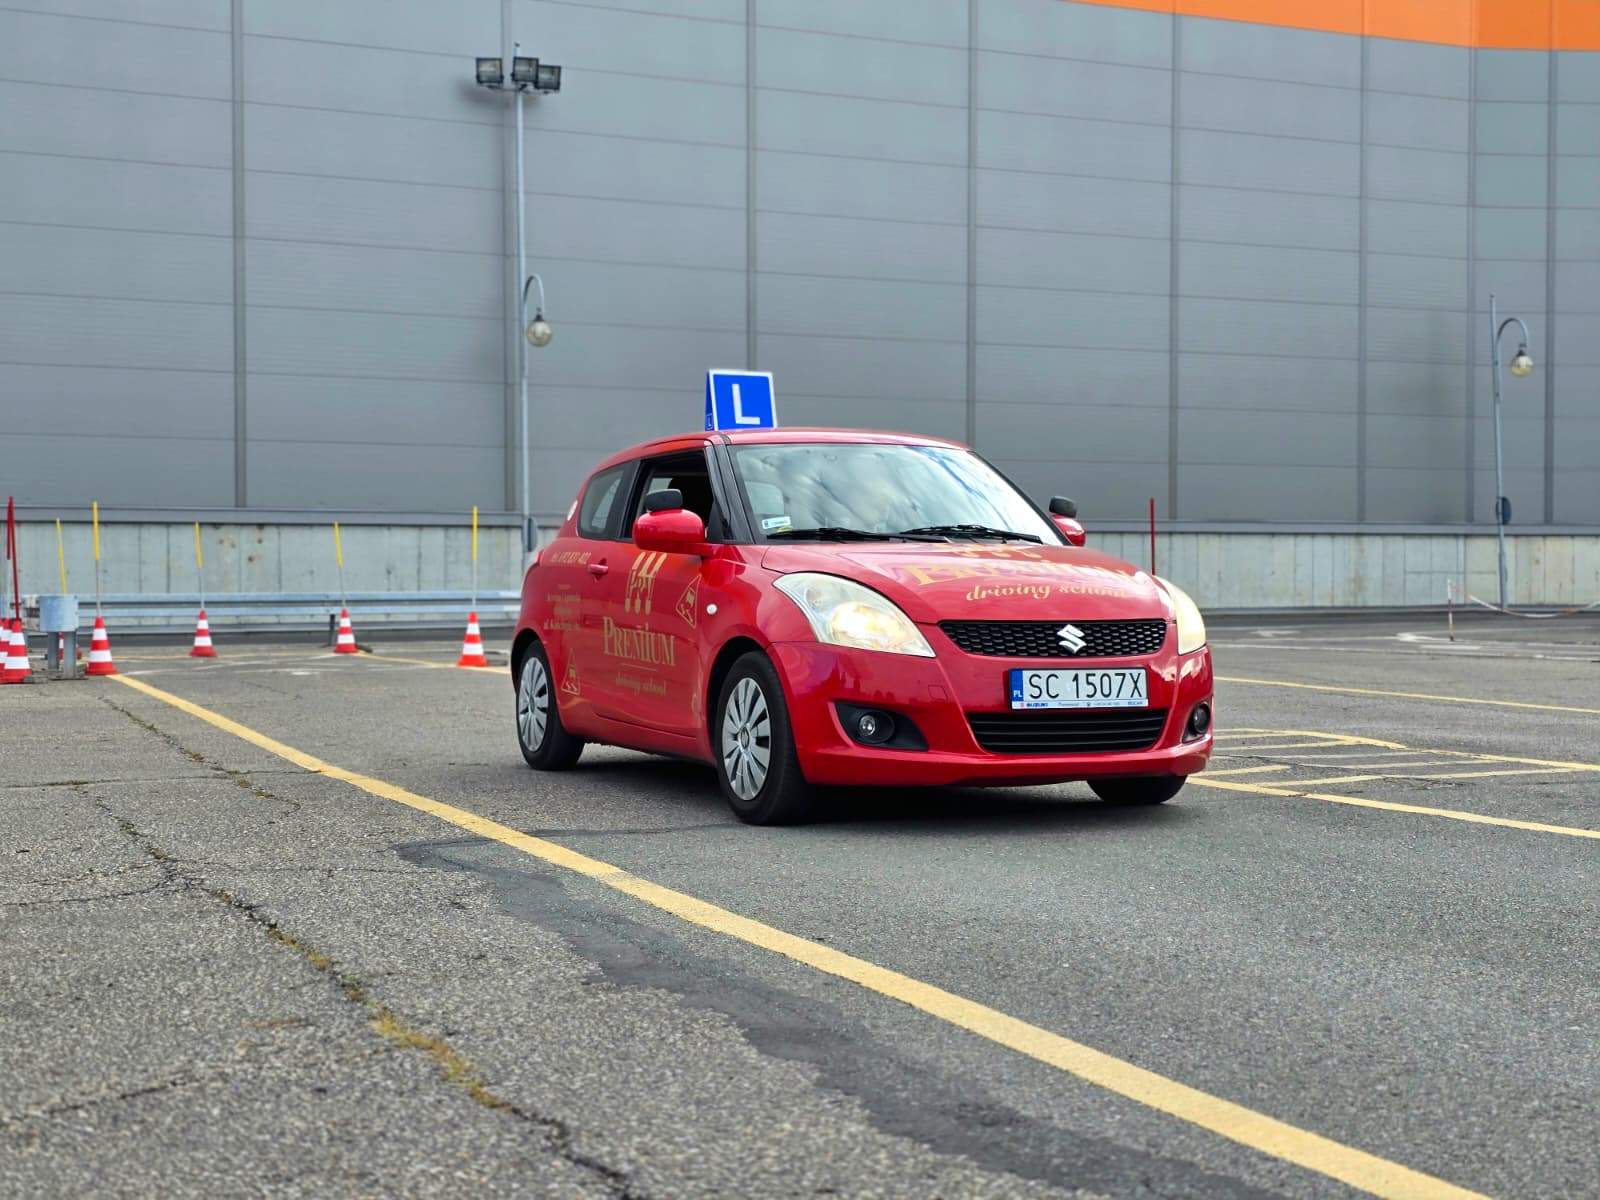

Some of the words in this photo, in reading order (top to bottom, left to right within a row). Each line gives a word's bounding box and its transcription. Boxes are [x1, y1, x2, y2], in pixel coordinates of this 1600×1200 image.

[731, 383, 761, 425] L
[966, 583, 1051, 601] driving
[1059, 582, 1129, 598] school
[1012, 689, 1023, 698] PL
[1028, 673, 1060, 699] SC
[1071, 672, 1143, 699] 1507X
